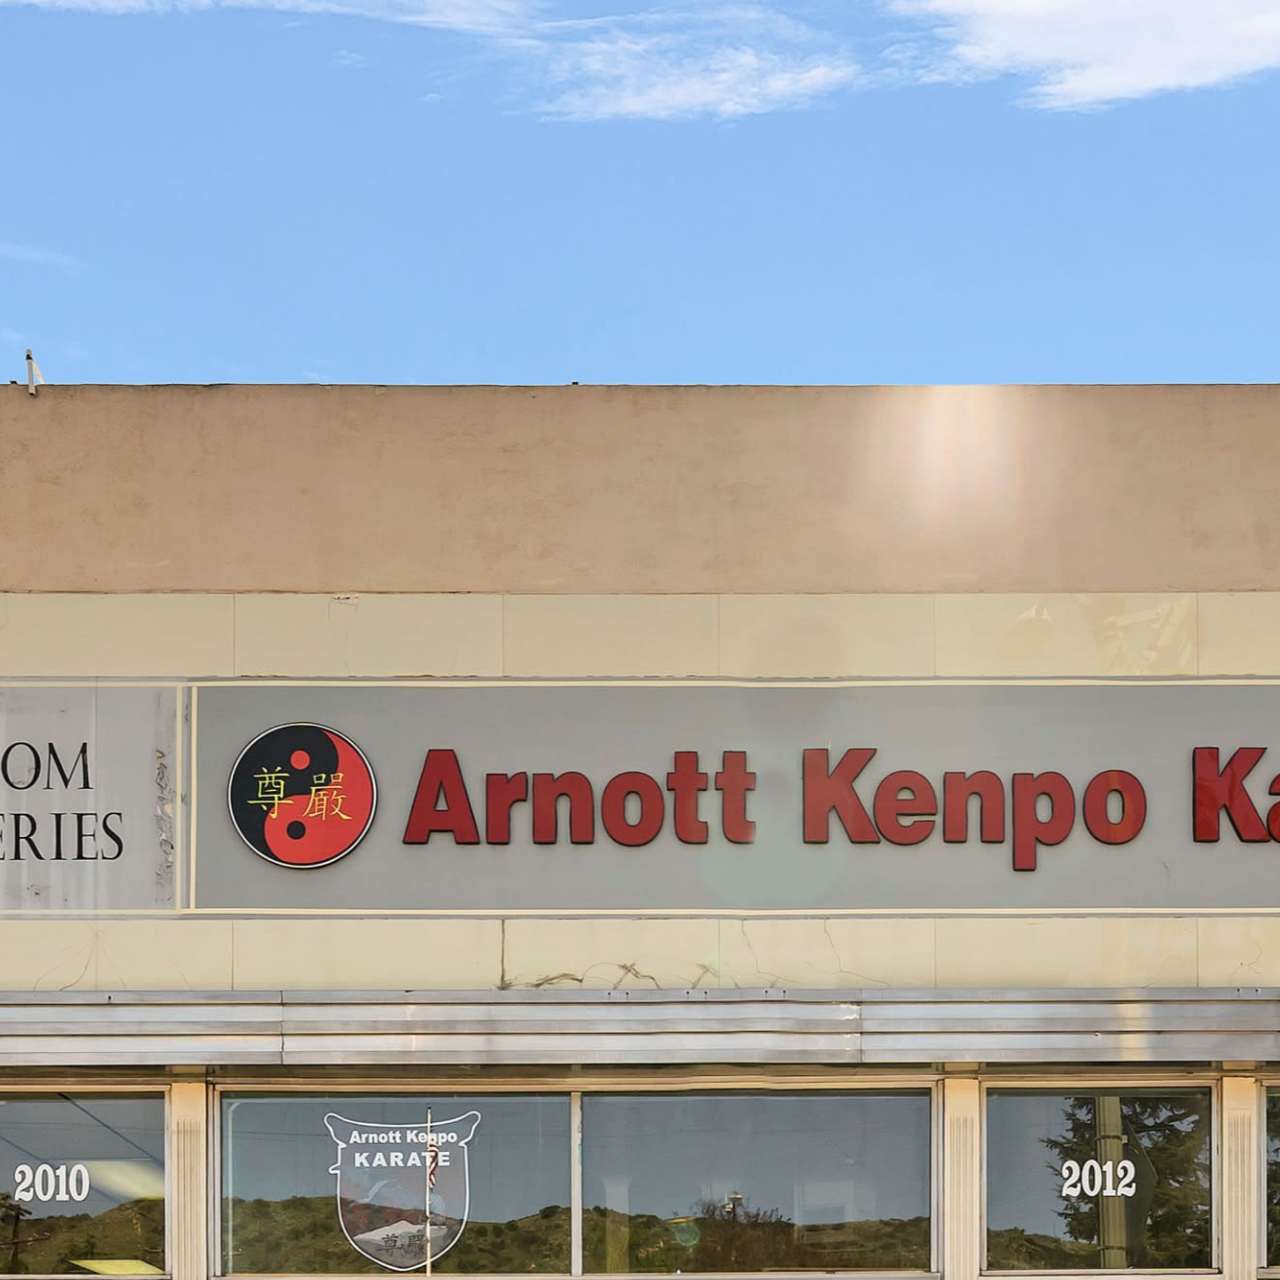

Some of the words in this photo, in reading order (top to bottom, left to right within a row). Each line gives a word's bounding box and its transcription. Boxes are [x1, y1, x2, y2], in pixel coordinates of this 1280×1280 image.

[247, 766, 353, 820] 尊嚴
[402, 748, 756, 846] Arnott
[802, 748, 1147, 871] Kenpo
[349, 1130, 402, 1144] Arnott
[354, 1151, 450, 1167] KARATE
[14, 1164, 90, 1202] 2010
[1061, 1160, 1136, 1197] 2012
